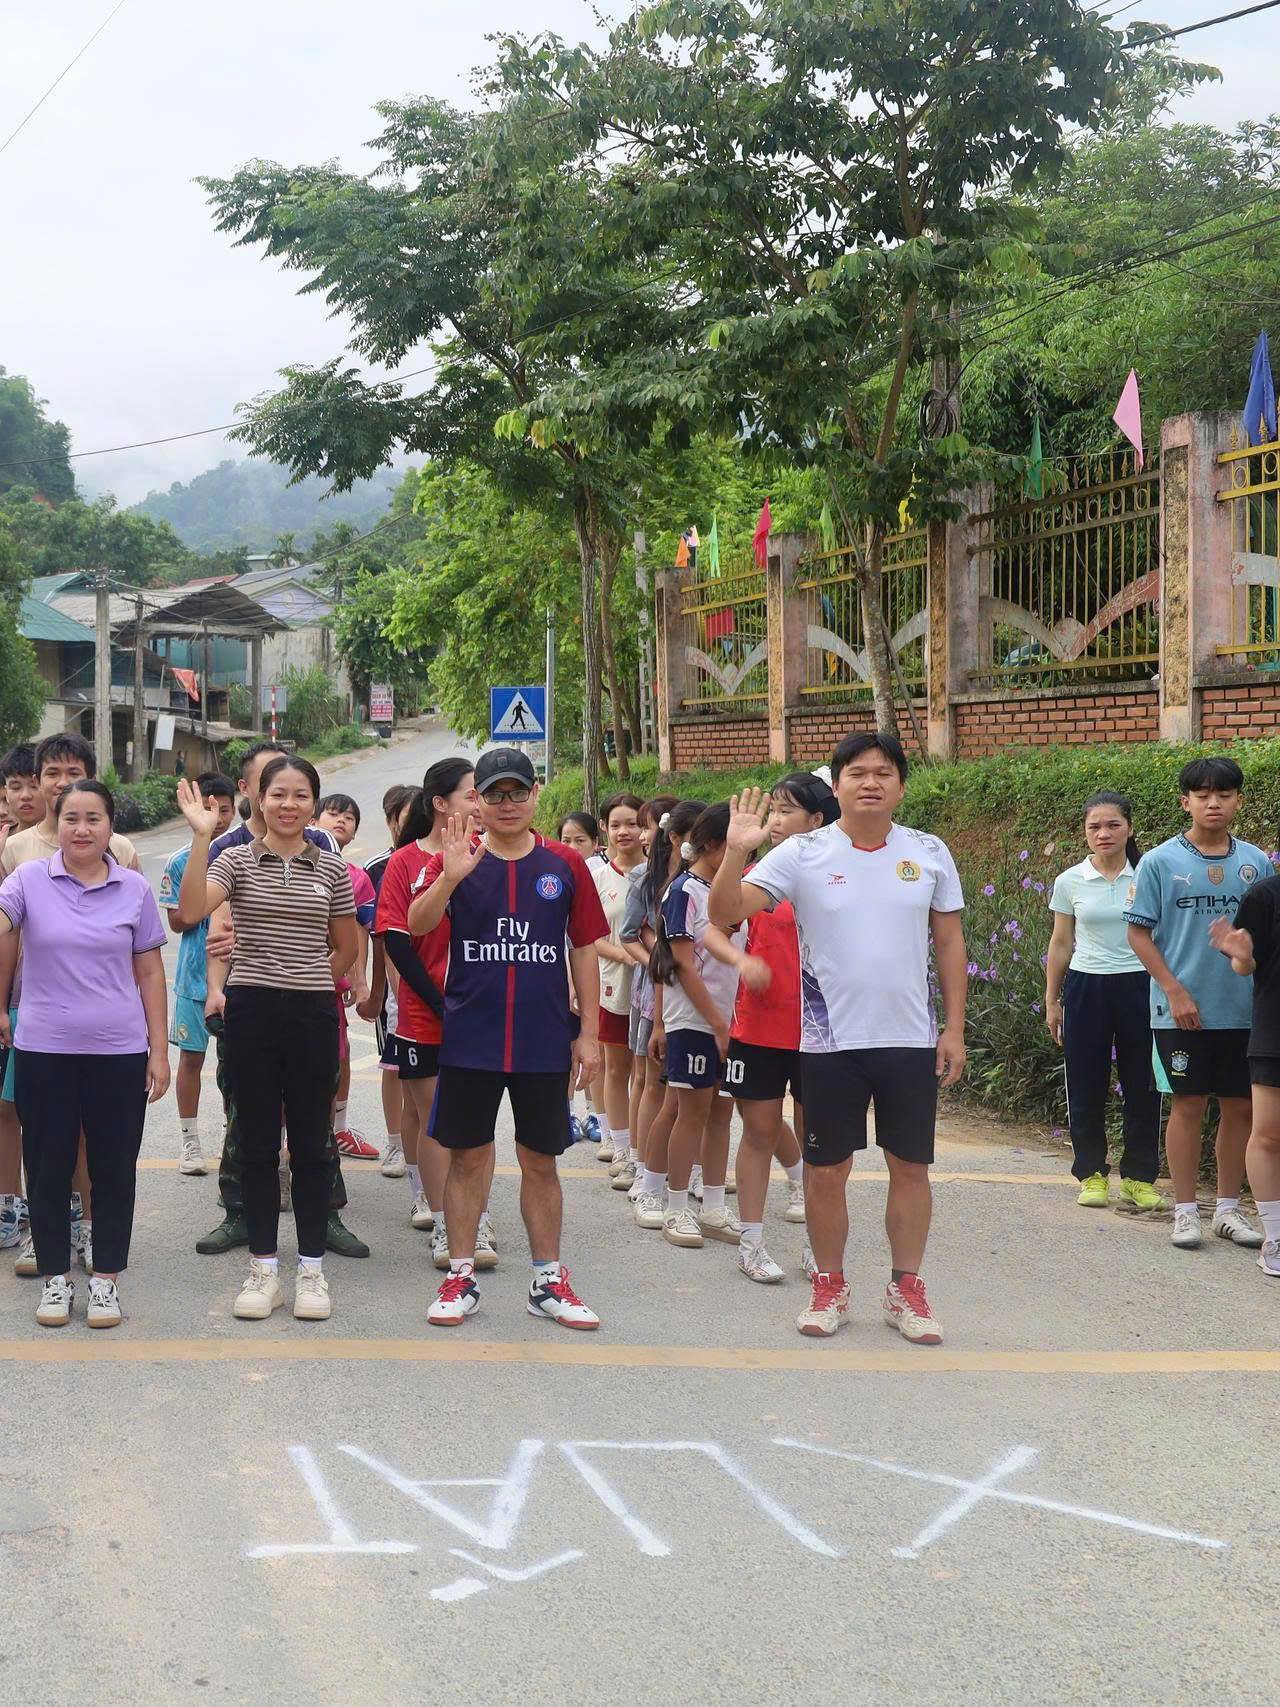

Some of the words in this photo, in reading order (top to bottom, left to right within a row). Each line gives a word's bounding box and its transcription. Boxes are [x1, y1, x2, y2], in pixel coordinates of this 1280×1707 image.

[1176, 895, 1243, 909] ETIHA
[497, 918, 529, 942] Fly
[463, 938, 557, 963] Emirates
[408, 1047, 418, 1066] 6
[687, 1053, 706, 1075] 10
[725, 1058, 745, 1084] 10
